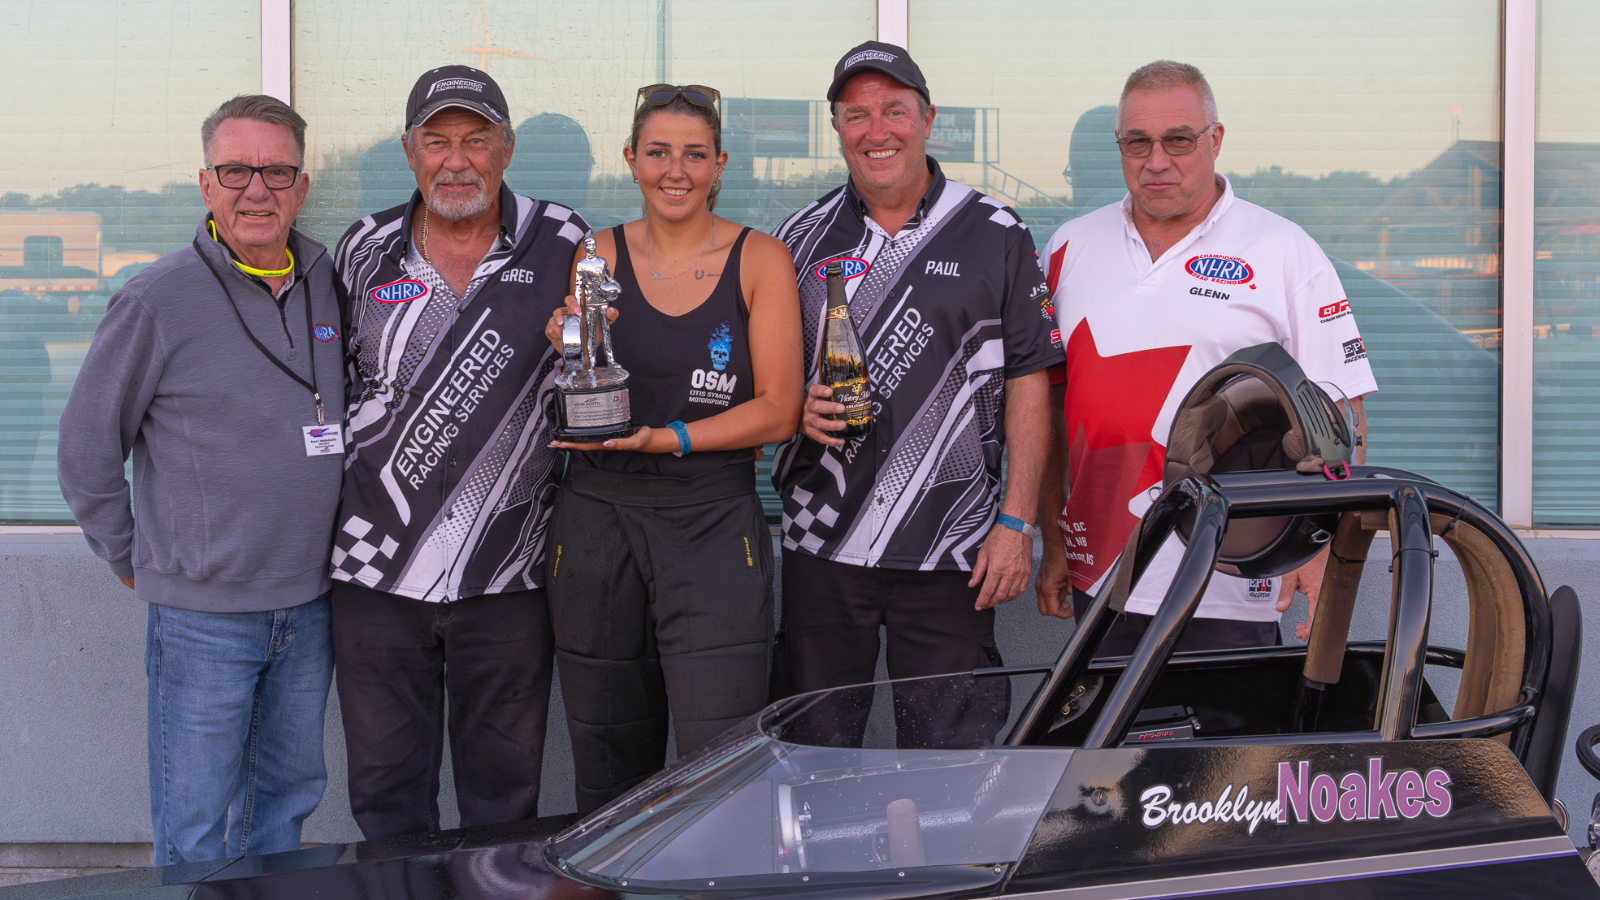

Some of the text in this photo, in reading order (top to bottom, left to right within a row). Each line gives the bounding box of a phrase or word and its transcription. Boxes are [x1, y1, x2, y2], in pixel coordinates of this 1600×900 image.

[436, 80, 483, 89] ENGINEERED
[1200, 254, 1246, 264] CHAMPIONSHIP
[500, 268, 534, 284] GREG
[924, 260, 961, 277] PAUL
[1194, 258, 1243, 279] NHRA
[1191, 272, 1209, 281] DRAG
[380, 283, 421, 300] NHRA
[1189, 287, 1231, 301] GLENN
[879, 323, 935, 400] SERVICES
[691, 368, 738, 394] OSM
[688, 396, 730, 407] MOTORSPORTS
[689, 389, 732, 401] OTIS SYMON
[396, 329, 501, 478] ENGINEERED
[408, 344, 515, 491] RACING SERVICES
[1073, 521, 1087, 532] QC
[1075, 536, 1088, 547] NB
[1138, 731, 1175, 740] PRO-DIAL
[1140, 757, 1452, 836] Brooklyn Noakes
